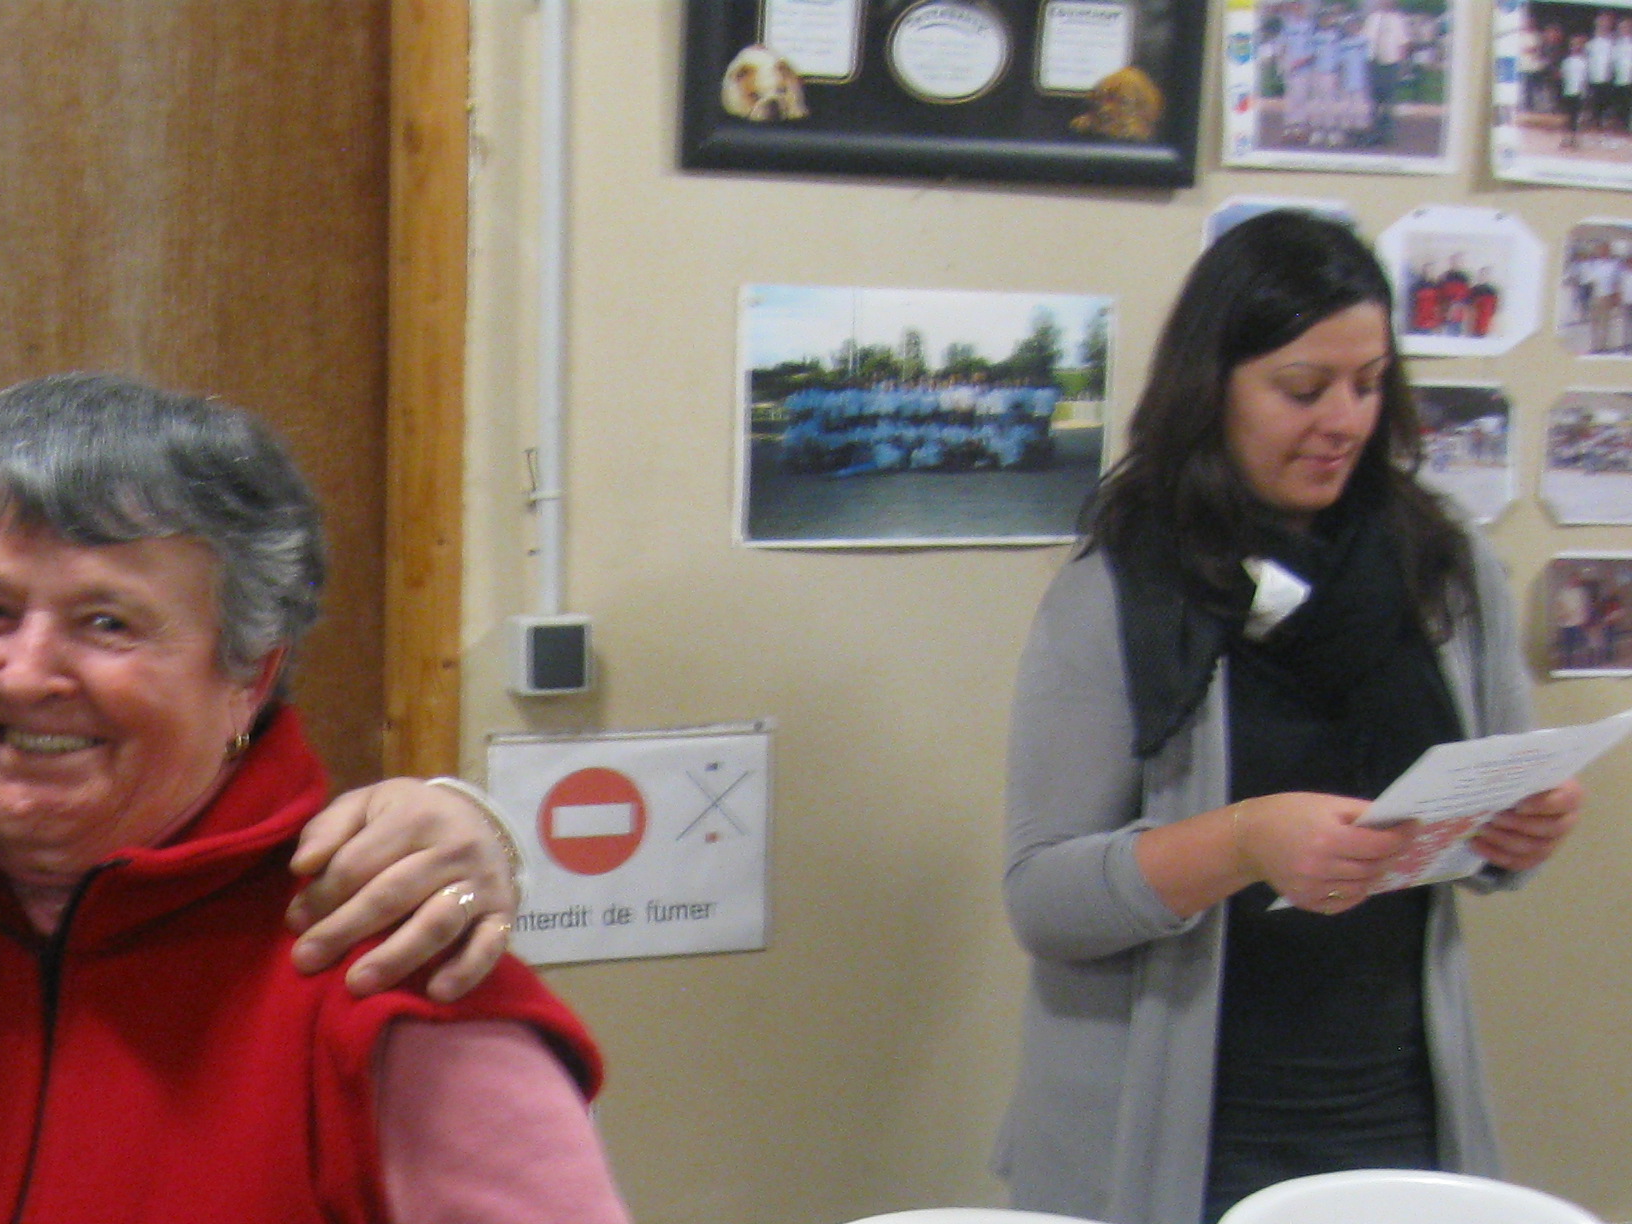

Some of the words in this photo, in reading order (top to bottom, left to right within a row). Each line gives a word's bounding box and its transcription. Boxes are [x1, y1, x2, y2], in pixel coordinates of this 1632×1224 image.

[515, 904, 591, 932] nterdit
[601, 903, 633, 926] de
[646, 900, 716, 923] fumer
